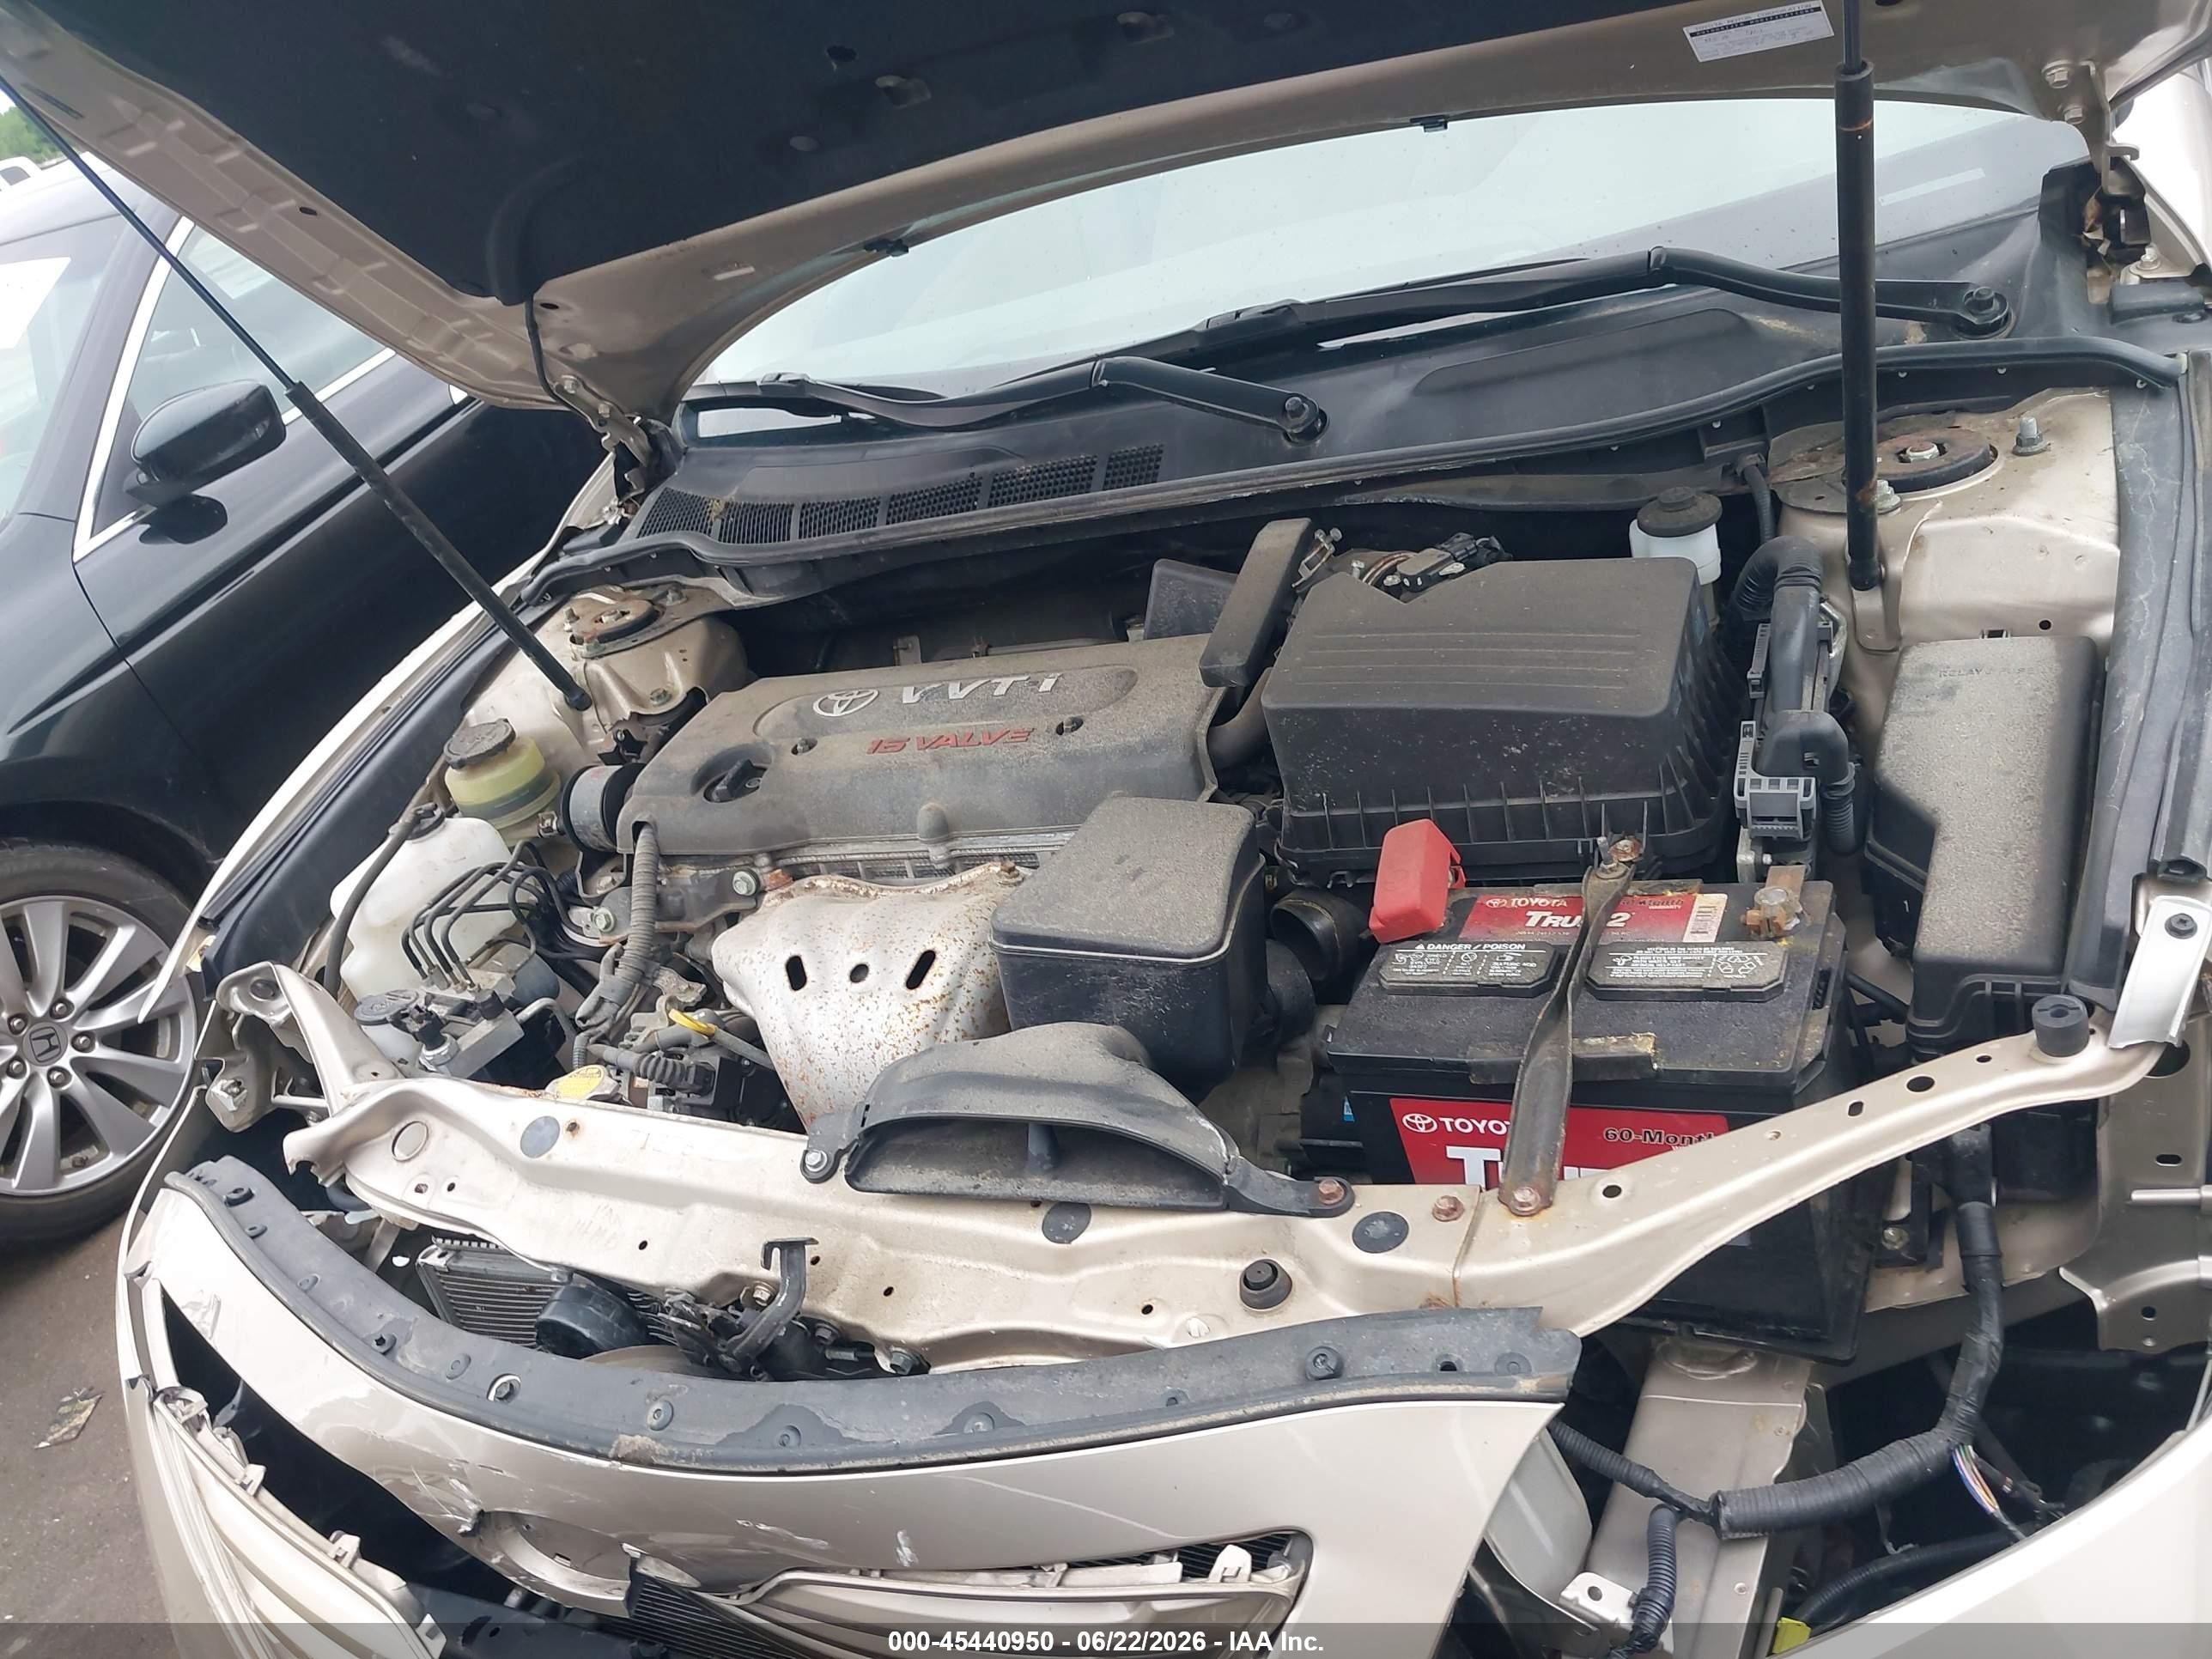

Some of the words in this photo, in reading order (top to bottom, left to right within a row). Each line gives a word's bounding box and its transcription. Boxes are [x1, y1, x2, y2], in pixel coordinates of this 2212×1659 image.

[916, 728, 1033, 750] VALVE
[1509, 897, 1567, 908] TOYOTA
[1439, 1117, 1510, 1135] TOYO
